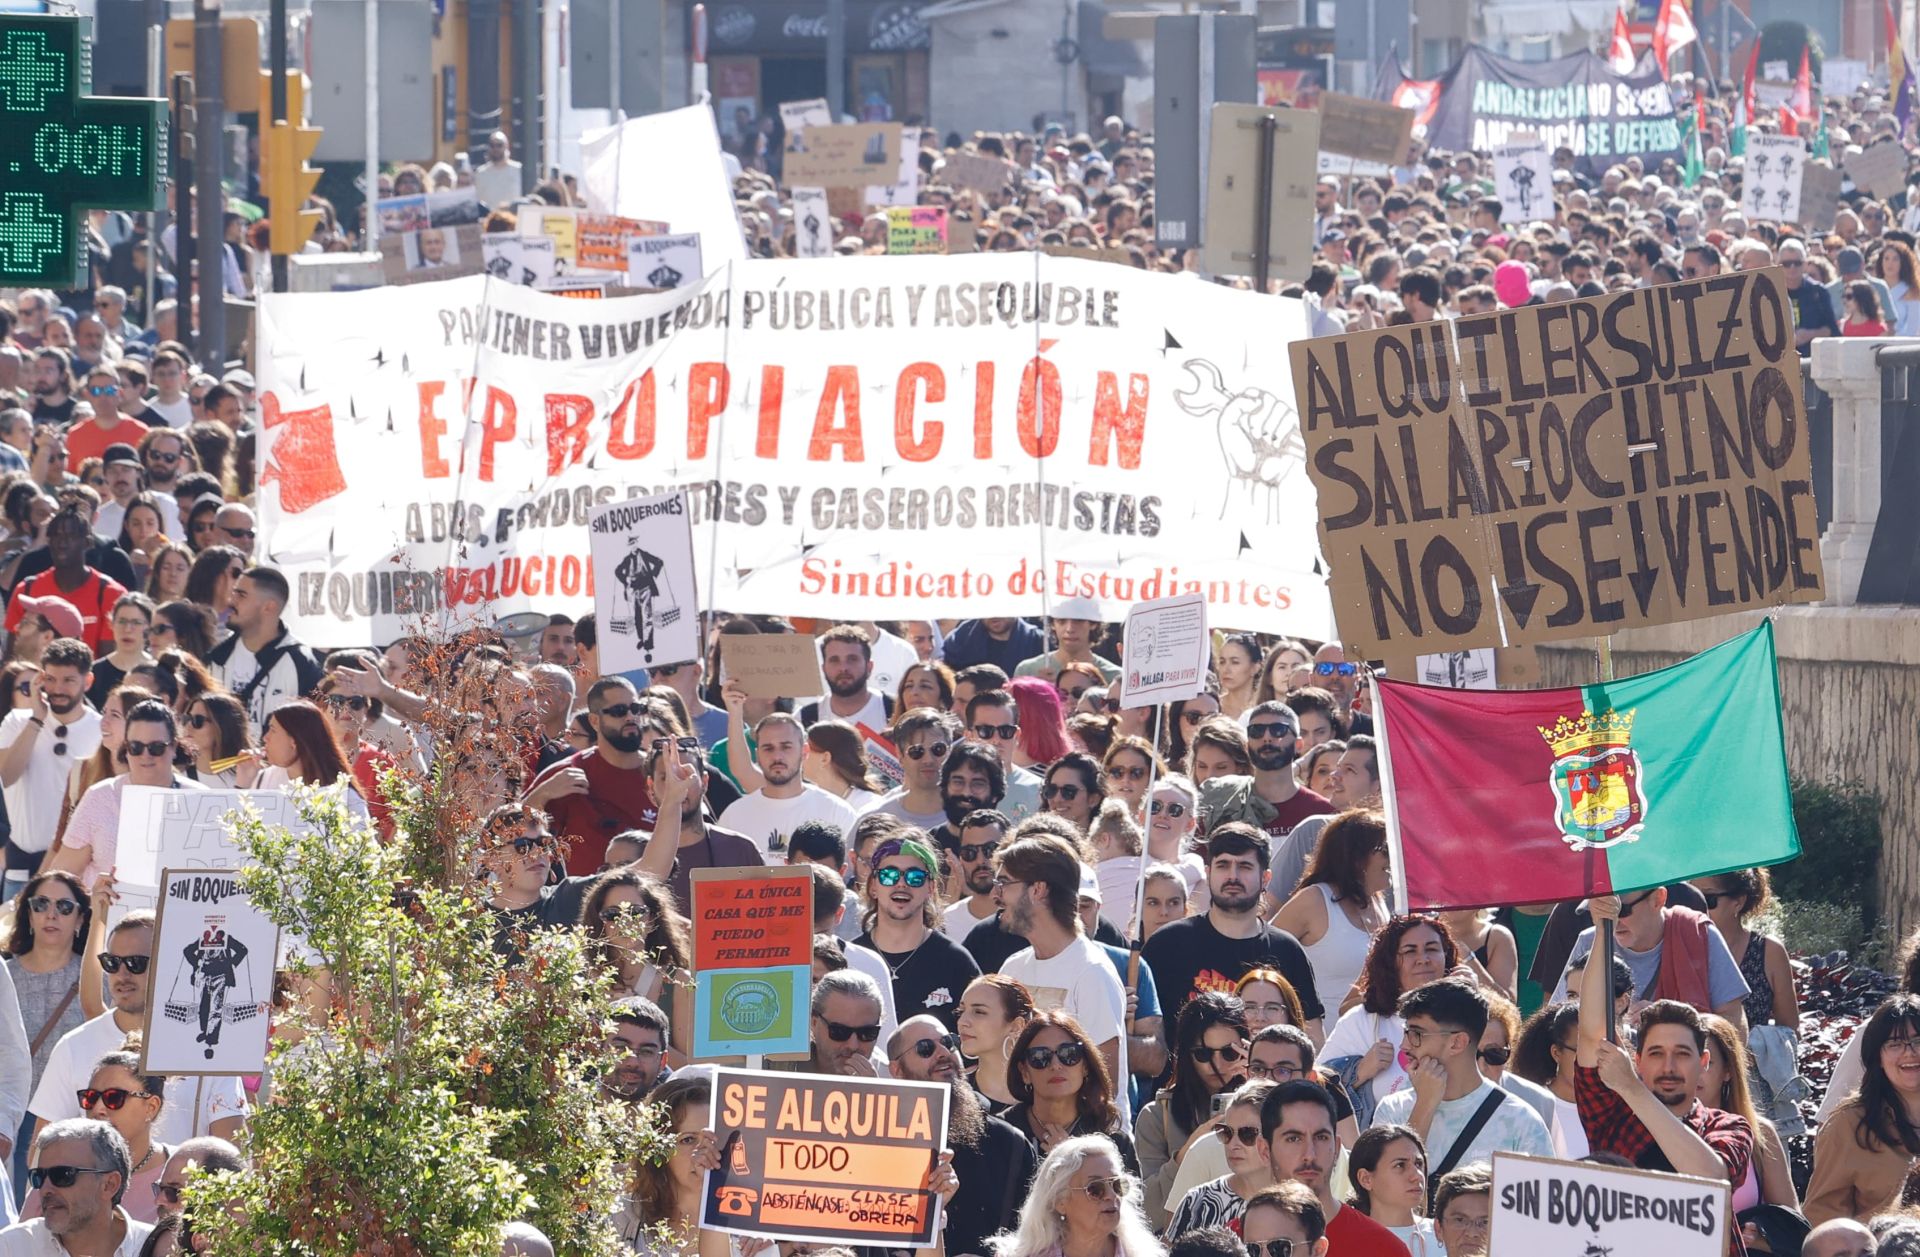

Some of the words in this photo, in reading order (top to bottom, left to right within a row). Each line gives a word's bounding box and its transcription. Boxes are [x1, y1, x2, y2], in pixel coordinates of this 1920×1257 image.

[1588, 82, 1611, 117] NO
[1587, 121, 1611, 156] SE
[492, 308, 572, 361] TENER
[578, 287, 730, 361] VIVIENDA
[743, 276, 895, 332] PÚBLICA
[905, 283, 927, 328] Y
[934, 281, 1120, 330] ASEQUIBLE
[416, 338, 1150, 482] EPROPIACIÓN
[592, 512, 609, 534] SIN
[609, 494, 683, 533] BOQUERONES
[777, 485, 802, 526] Y
[810, 485, 977, 531] CASEROS
[984, 483, 1163, 538] RENTISTAS
[1359, 534, 1483, 641] NO
[1524, 506, 1626, 628] SE
[1656, 480, 1820, 607] VENDE
[801, 557, 993, 598] Sindicato
[1007, 556, 1045, 596] de
[1055, 560, 1292, 610] Estudiantes
[169, 878, 191, 901] SIN
[735, 888, 755, 899] LA
[759, 884, 803, 900] ÚNICA
[704, 907, 741, 920] CASA
[745, 906, 777, 919] QUE
[778, 905, 806, 917] ME
[711, 928, 766, 941] PUEDO
[715, 946, 791, 961] PERMITIR
[722, 1083, 768, 1129] SE
[775, 1087, 933, 1141] ALQUILA
[851, 1190, 913, 1207] CLASE
[1500, 1179, 1540, 1220] SIN
[1548, 1178, 1715, 1237] BOQUERONES
[849, 1210, 919, 1227] OBRERA
